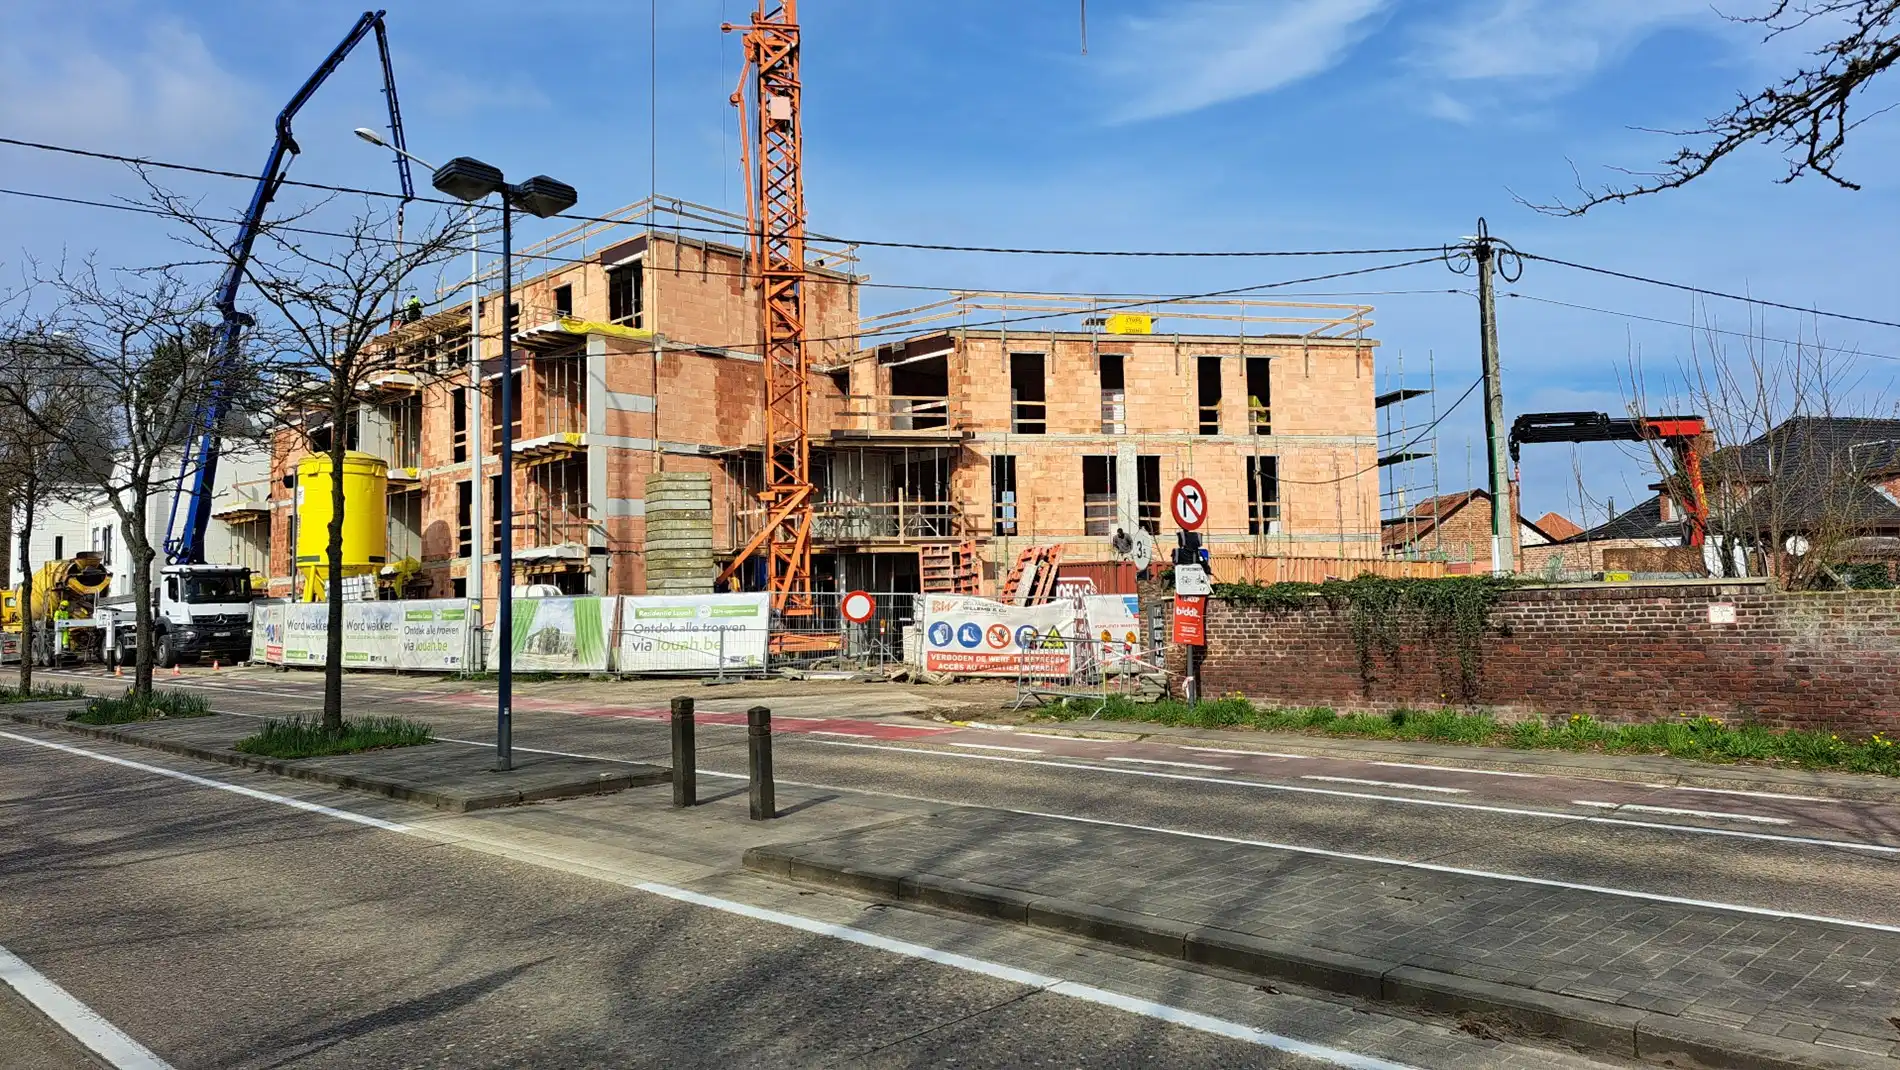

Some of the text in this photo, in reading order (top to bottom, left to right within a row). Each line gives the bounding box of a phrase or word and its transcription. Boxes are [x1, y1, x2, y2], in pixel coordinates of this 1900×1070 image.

[287, 618, 328, 630] Word wakke
[346, 620, 365, 631] Word
[367, 619, 392, 631] wakker
[426, 625, 435, 634] alle
[633, 622, 746, 634] Ontdek alle troeven
[404, 639, 414, 651] via
[632, 638, 653, 652] via
[931, 653, 973, 662] VERBODEN
[976, 655, 986, 663] DE
